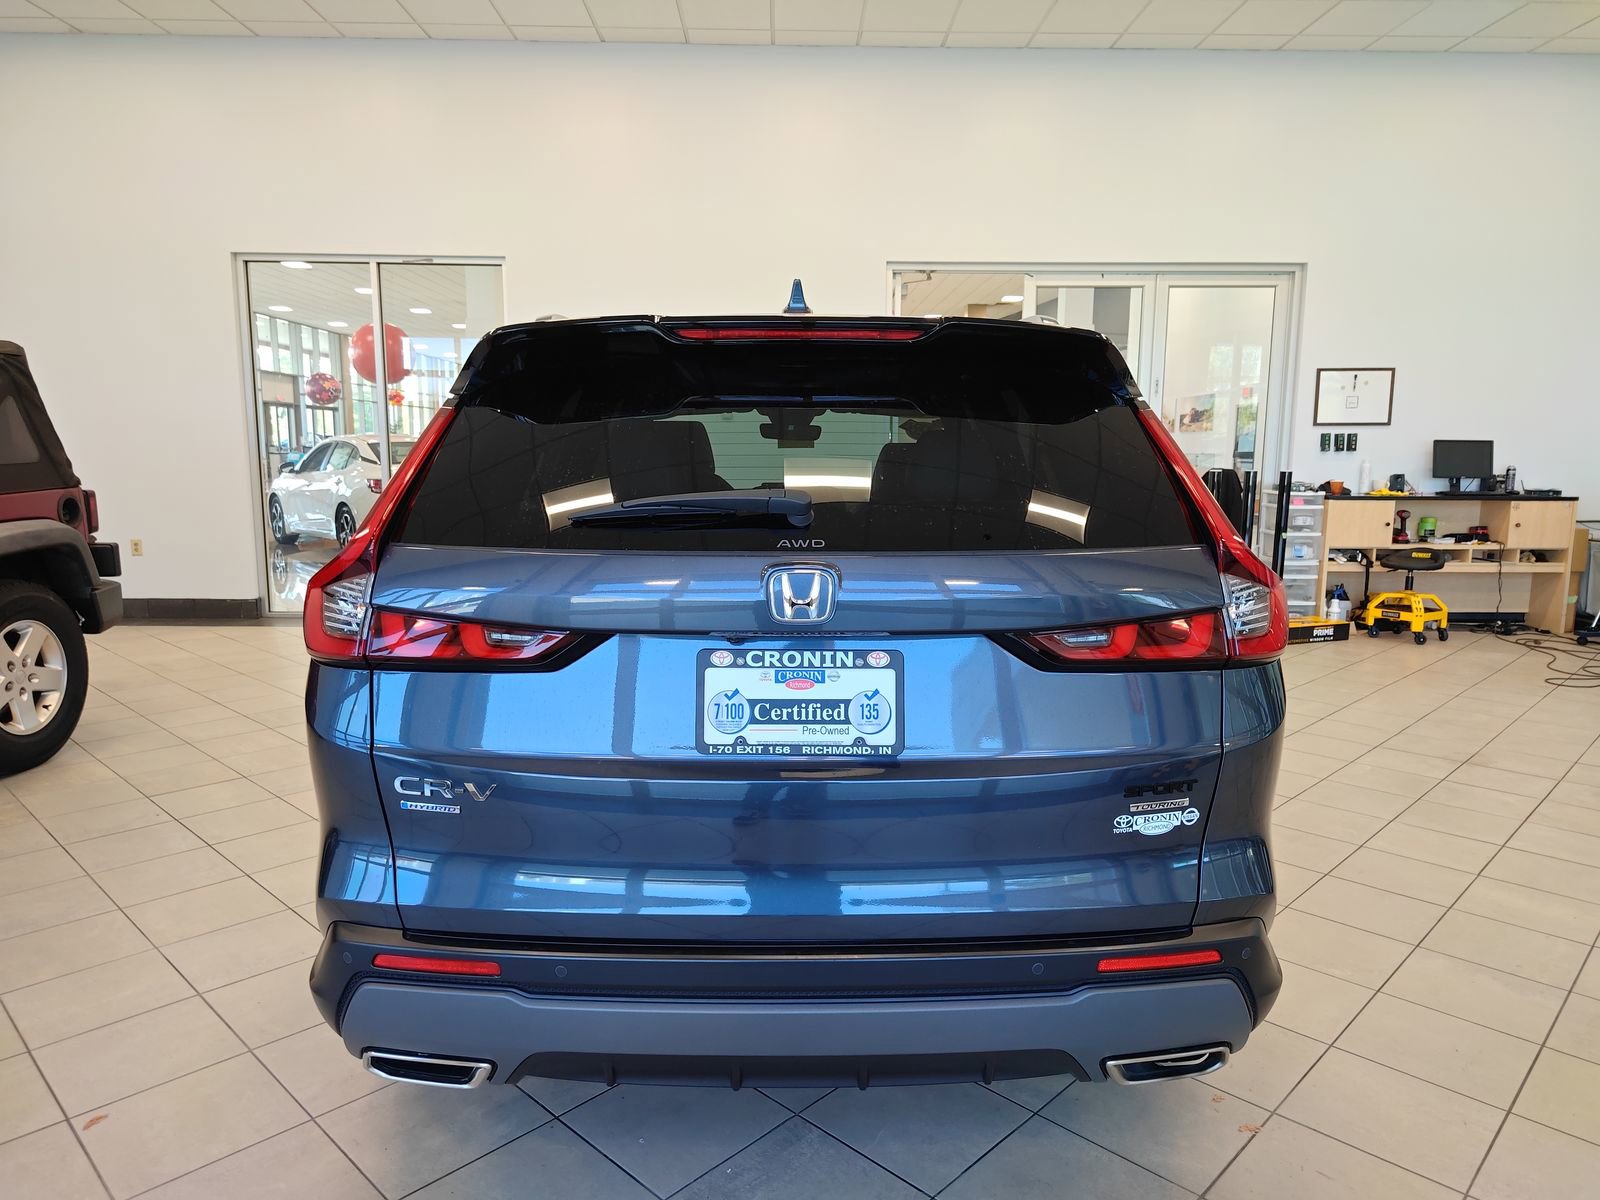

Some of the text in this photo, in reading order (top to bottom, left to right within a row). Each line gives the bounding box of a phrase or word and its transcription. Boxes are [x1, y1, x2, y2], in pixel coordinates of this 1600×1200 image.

[776, 539, 825, 548] AWD
[1313, 628, 1335, 637] PRIME
[746, 650, 854, 668] CRONIN
[777, 671, 822, 682] CRONIN
[753, 702, 846, 721] Certified
[859, 703, 880, 720] 135
[802, 726, 850, 736] Pre-Owned
[709, 746, 732, 754] I-70
[736, 746, 764, 754] EXIT
[768, 746, 791, 754] 156
[879, 746, 892, 755] IN
[393, 775, 497, 802] CR-V
[1123, 778, 1199, 798] SPORT
[408, 802, 457, 813] HYBRID
[1131, 801, 1186, 811] TOURING
[1134, 812, 1180, 827] CRONIN
